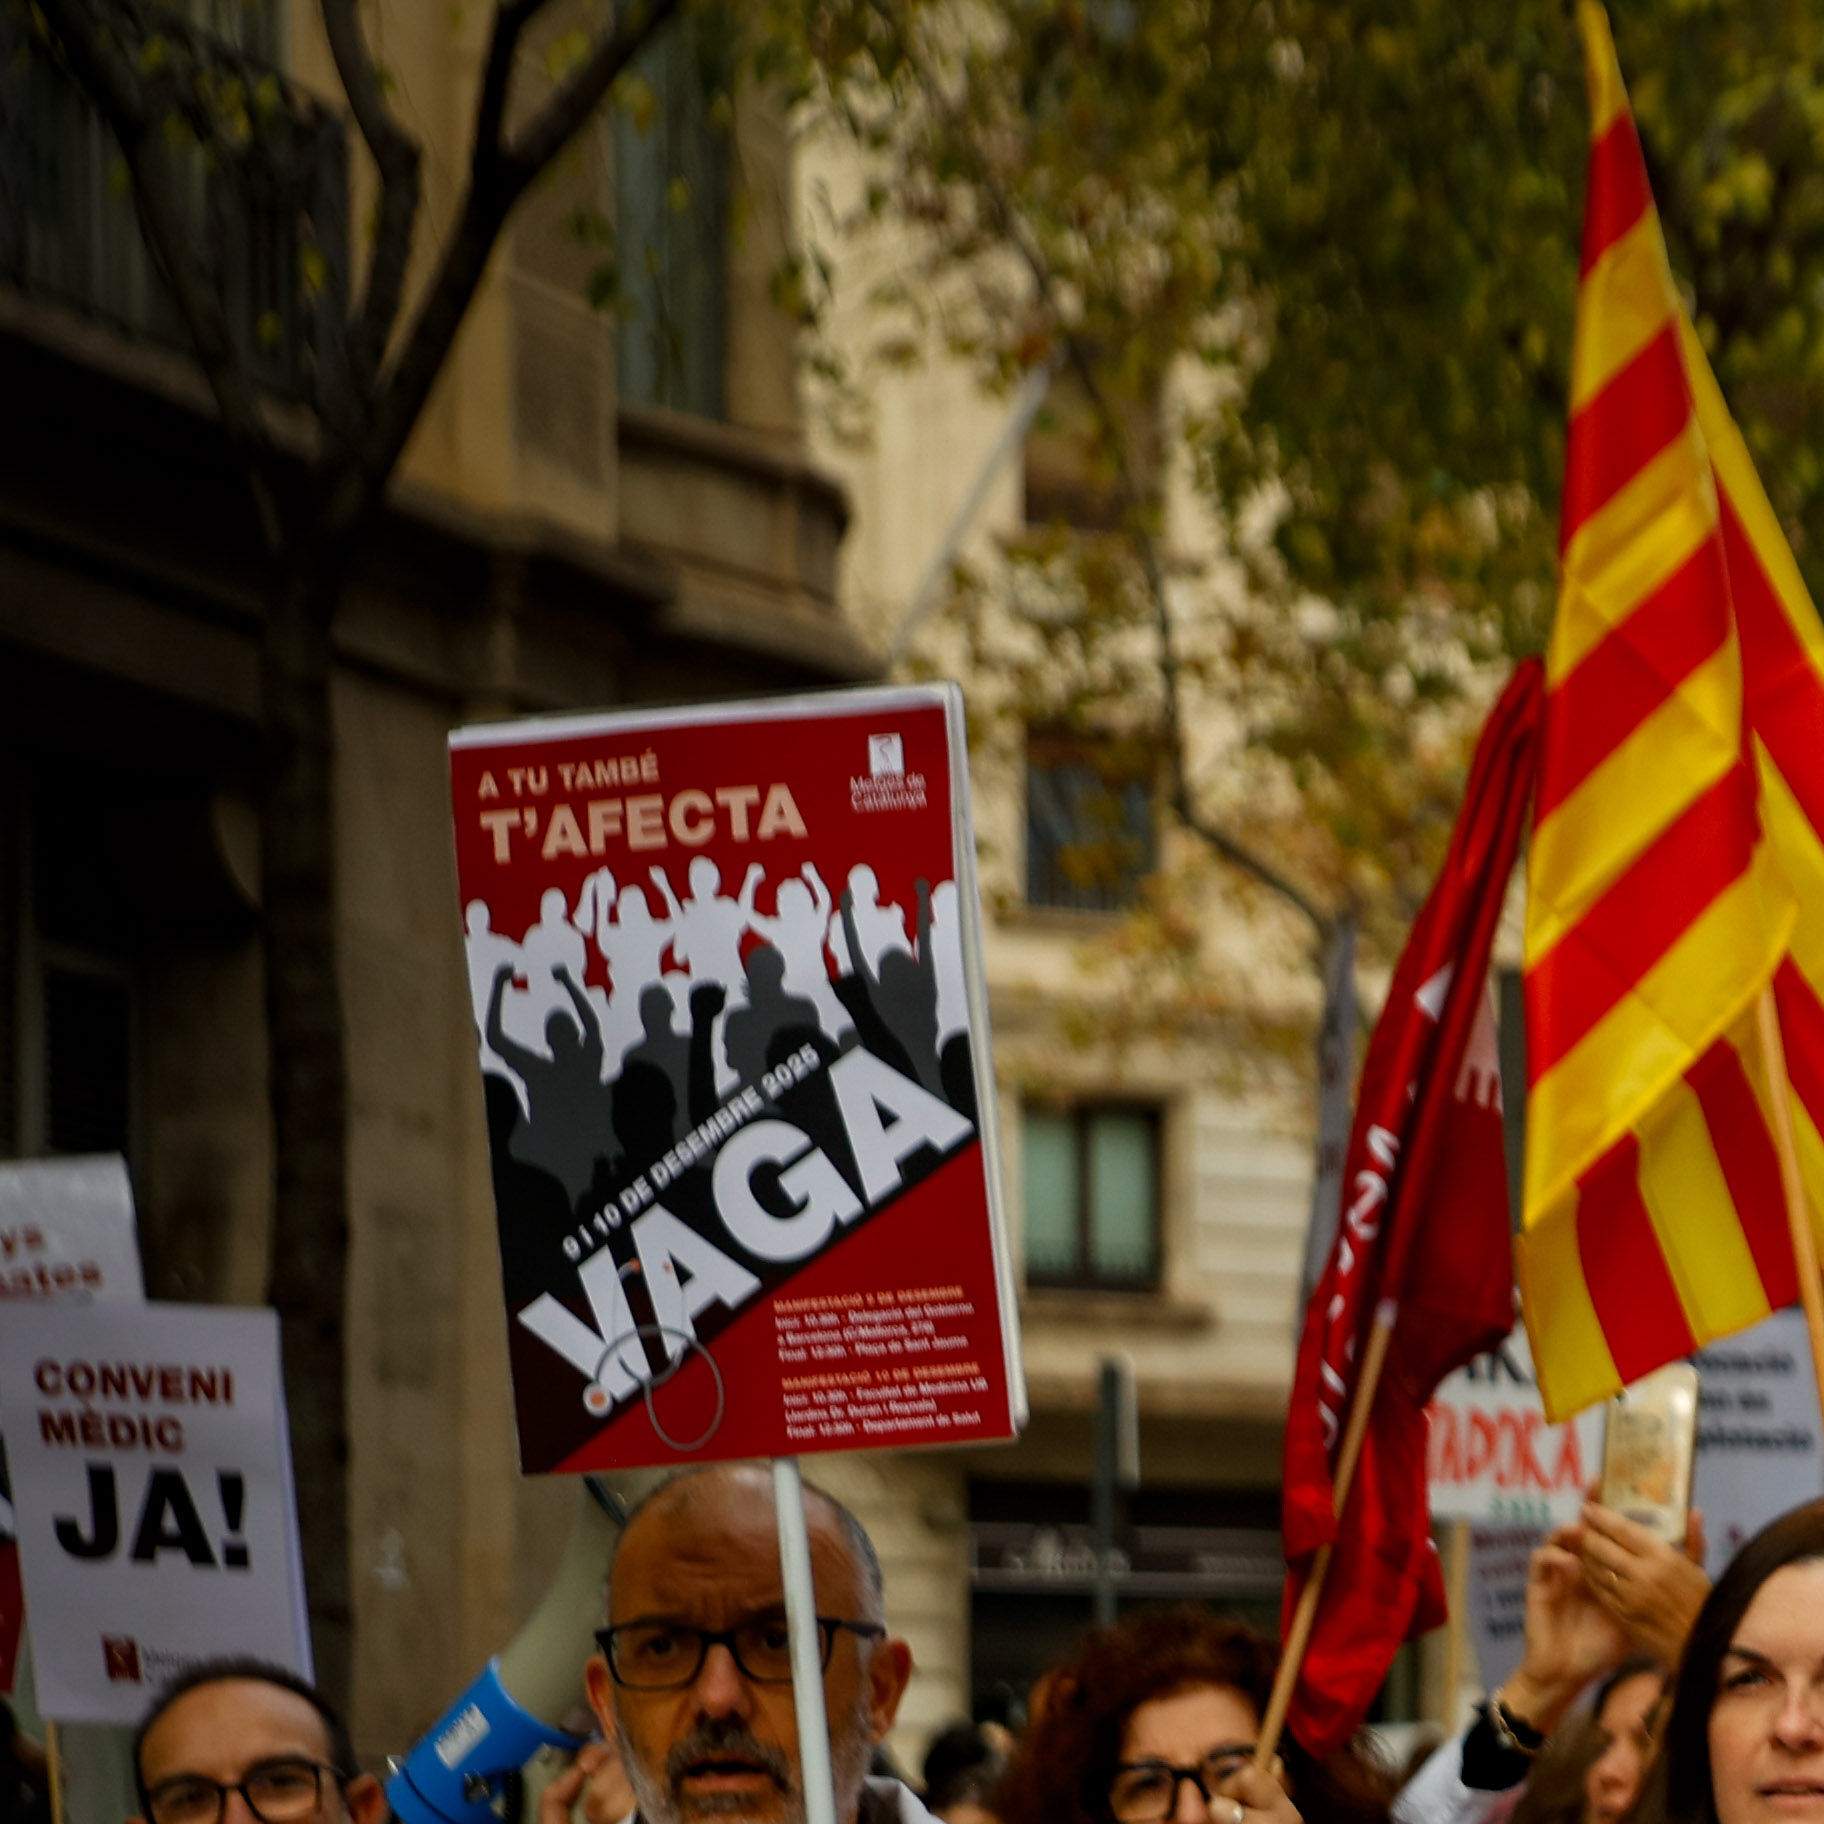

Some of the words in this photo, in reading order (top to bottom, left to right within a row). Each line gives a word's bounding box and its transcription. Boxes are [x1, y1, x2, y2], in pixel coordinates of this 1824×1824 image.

[479, 770, 500, 799] A
[507, 765, 548, 797] TU
[557, 747, 661, 793] TAMBÉ
[479, 782, 809, 865] T'AFECTA
[562, 1235, 581, 1262] 9
[593, 1203, 622, 1237] 10
[619, 1174, 655, 1215] DE
[649, 1084, 765, 1191] DESEMBRE
[761, 1042, 821, 1100] 2025
[517, 1045, 977, 1402] VAGA
[33, 1359, 235, 1407] CONVENI
[37, 1400, 184, 1455] MÈDIC
[53, 1459, 251, 1574] JA!
